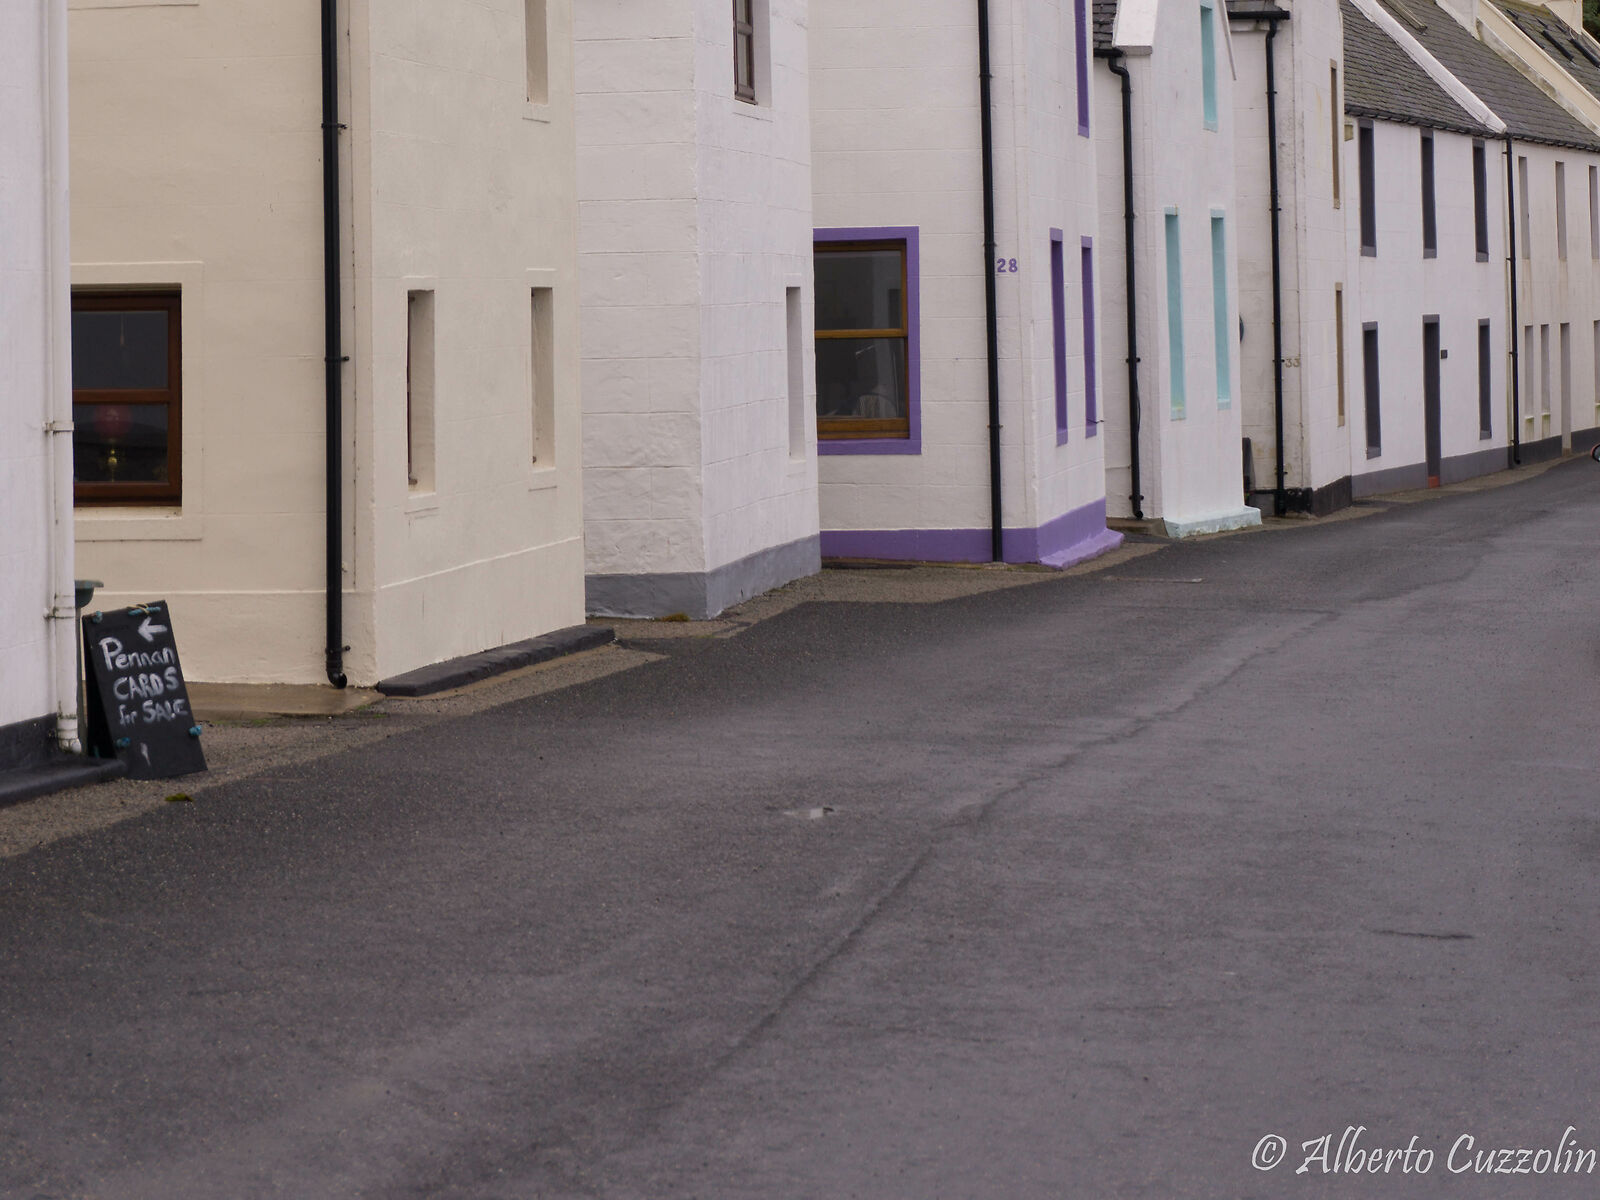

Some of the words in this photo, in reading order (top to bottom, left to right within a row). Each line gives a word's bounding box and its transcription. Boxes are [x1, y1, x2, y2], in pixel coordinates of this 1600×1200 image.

[996, 257, 1018, 273] 28
[99, 636, 176, 672] Pennan
[113, 665, 180, 701] CARDS
